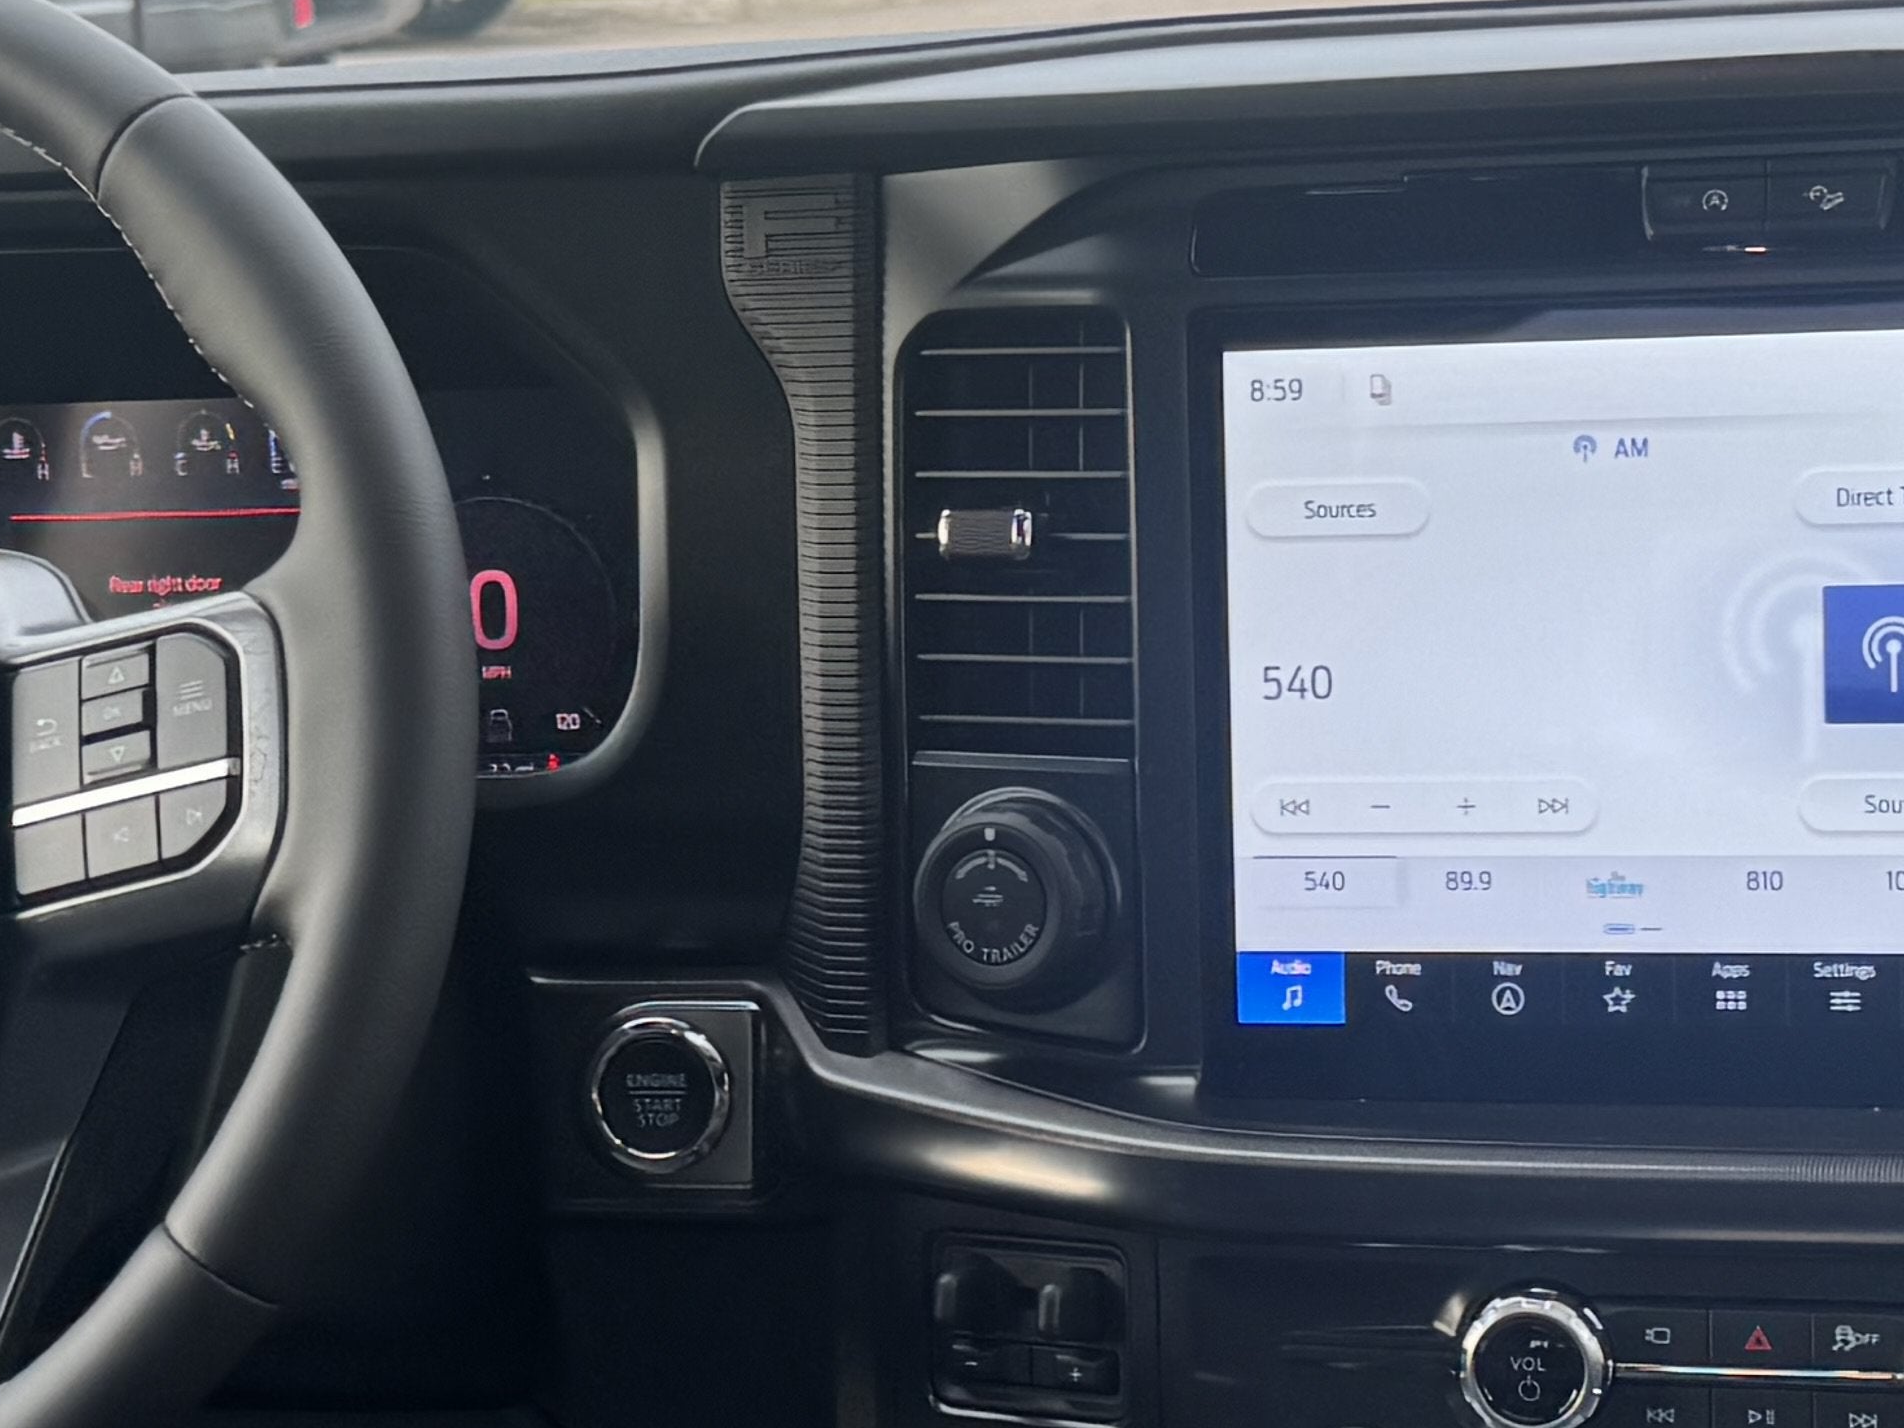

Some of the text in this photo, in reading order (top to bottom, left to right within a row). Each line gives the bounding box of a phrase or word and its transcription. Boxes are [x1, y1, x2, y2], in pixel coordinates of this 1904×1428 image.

[1249, 378, 1303, 403] 8:59
[1614, 436, 1649, 458] AM
[1836, 486, 1894, 509] Direct
[1303, 499, 1377, 521] Sources
[109, 574, 222, 596] Rear right door
[470, 569, 518, 651] 0
[1262, 663, 1334, 701] 540
[1304, 871, 1345, 892] 540
[1445, 871, 1492, 892] 89.9
[1746, 870, 1783, 892] 810
[948, 922, 1040, 963] PRO TRAILER
[1270, 959, 1312, 976] Audio
[1376, 960, 1422, 976] Phone
[1493, 960, 1523, 976] Nav
[1604, 960, 1633, 977] Fav
[1712, 961, 1751, 980] Apps
[1813, 961, 1877, 980] Settings
[626, 1073, 687, 1088] ENGINE
[634, 1098, 681, 1112] START
[637, 1113, 679, 1128] STOP
[1509, 1356, 1546, 1371] VOL
